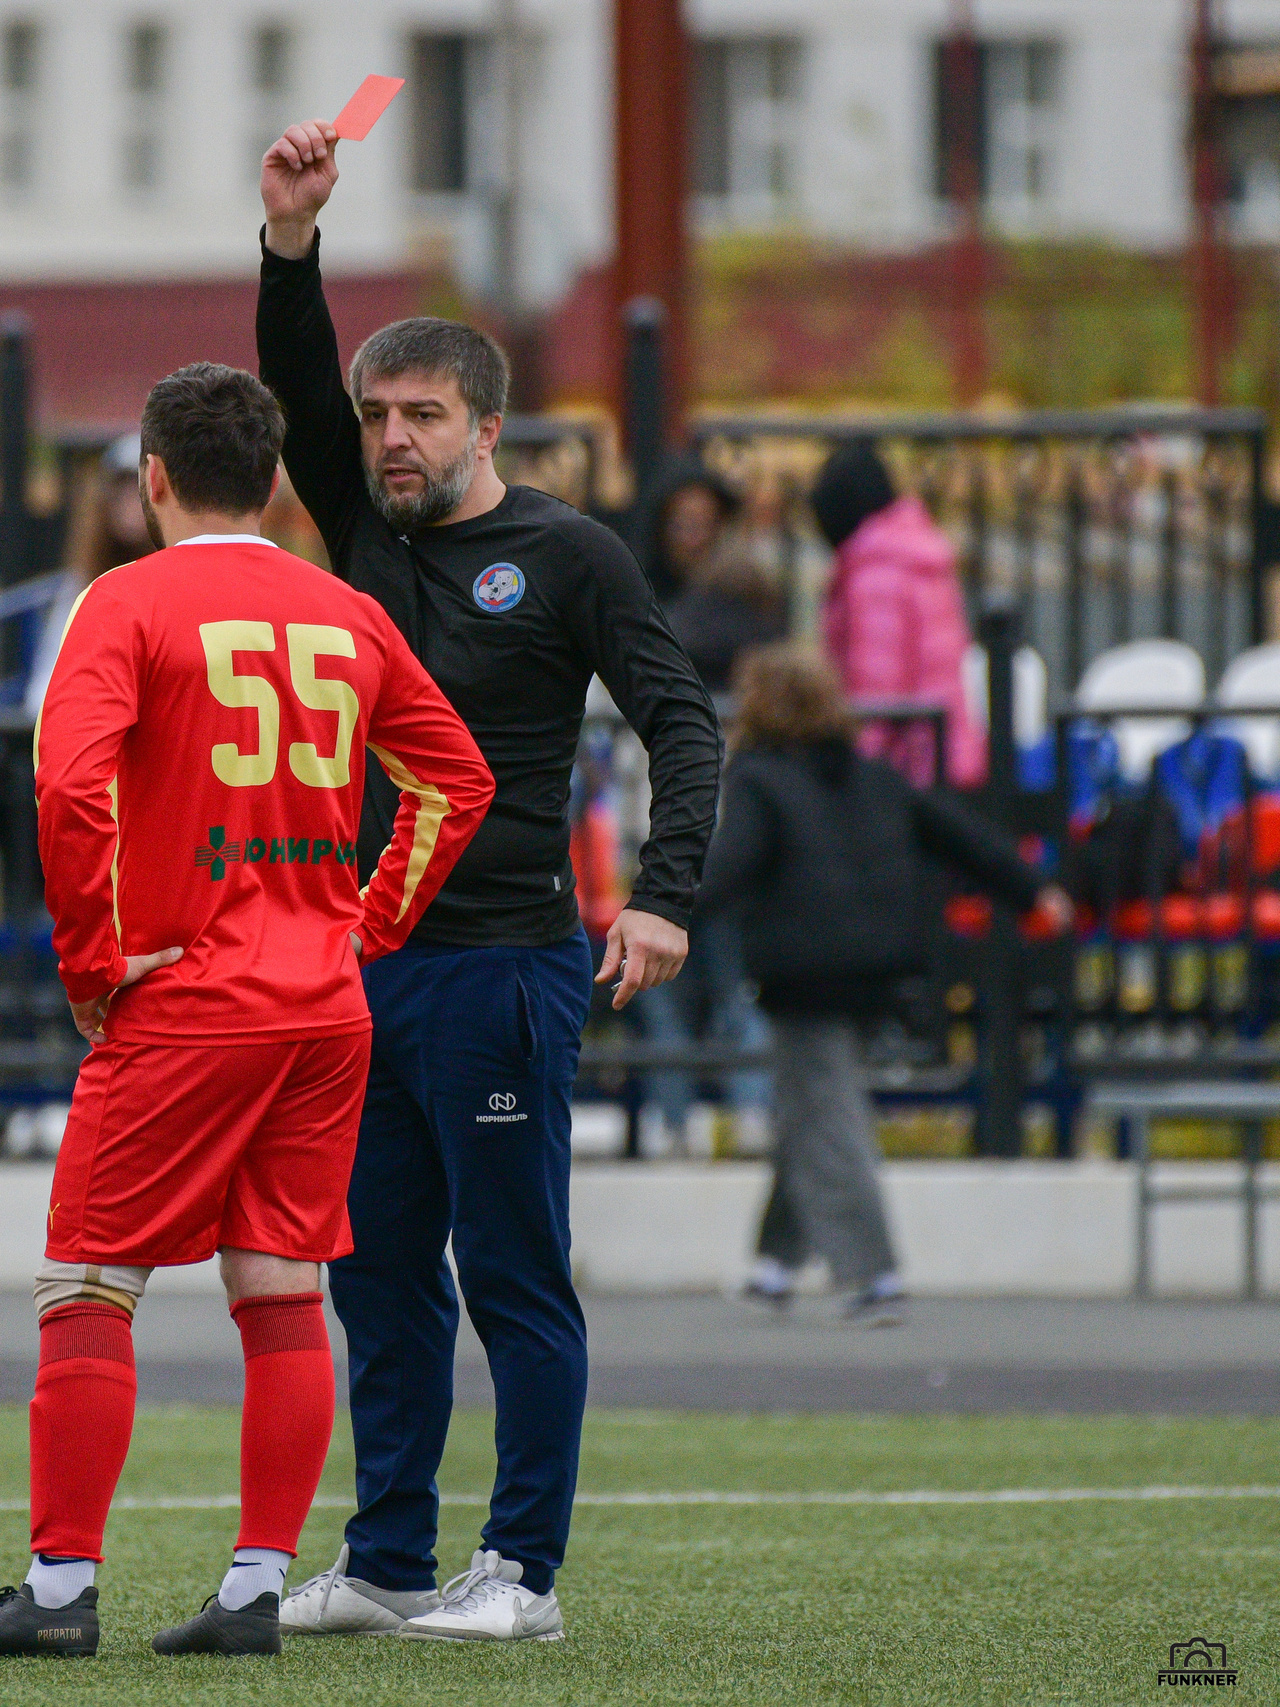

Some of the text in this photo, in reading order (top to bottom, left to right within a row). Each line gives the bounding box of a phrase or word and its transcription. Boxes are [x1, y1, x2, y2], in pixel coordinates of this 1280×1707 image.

[198, 619, 360, 788] 55
[476, 1113, 528, 1123] НОРНИКЕЛЬ
[37, 1628, 82, 1641] PREDATOR
